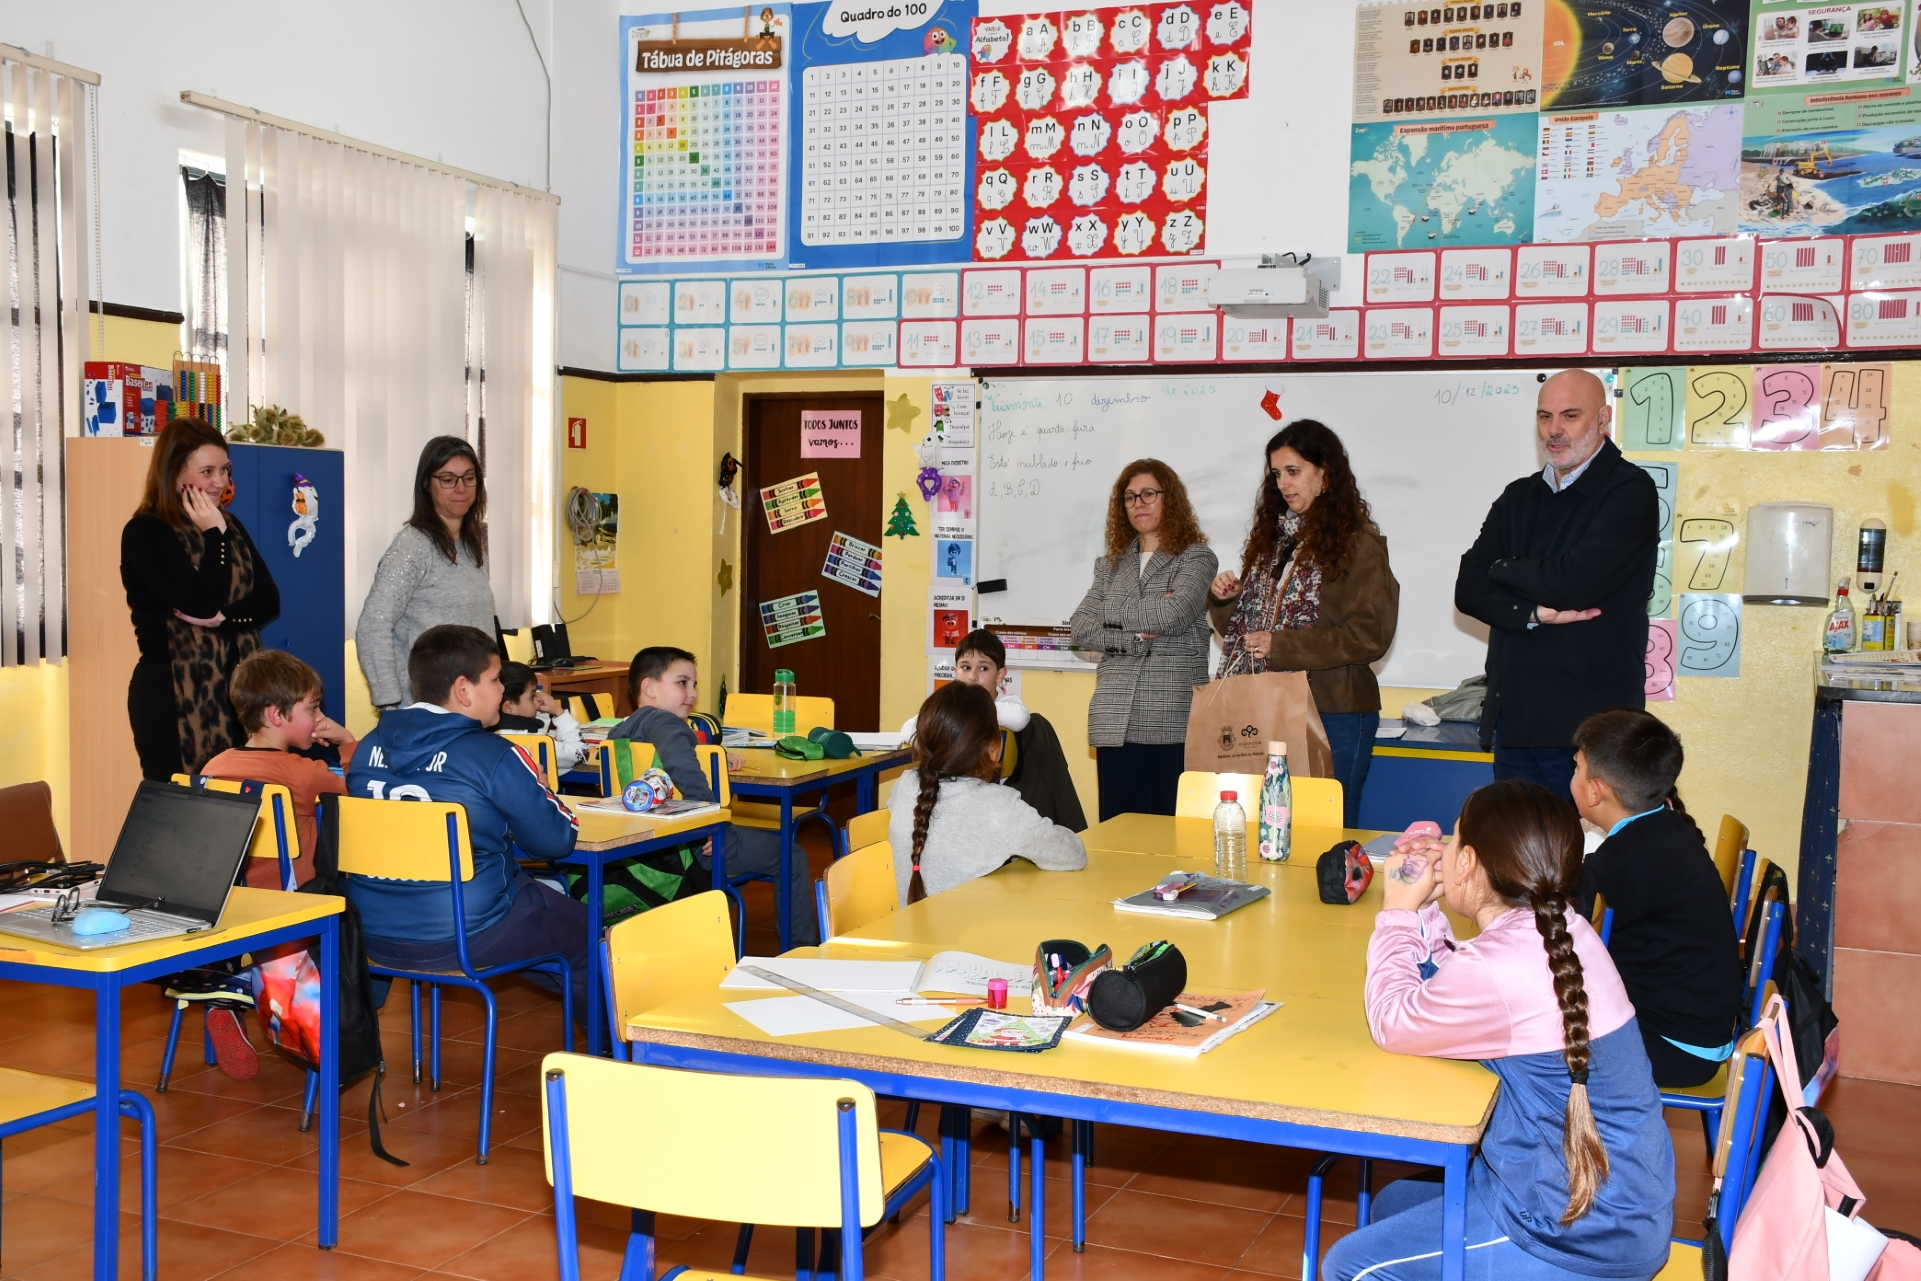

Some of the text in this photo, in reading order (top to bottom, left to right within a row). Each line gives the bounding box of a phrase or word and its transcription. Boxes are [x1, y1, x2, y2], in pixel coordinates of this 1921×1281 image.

[840, 2, 928, 24] Quadro do 100
[1180, 12, 1190, 24] D
[1231, 8, 1238, 19] E
[1807, 5, 1852, 16] SEGURANÇA
[975, 33, 1010, 43] Alfabeto!
[642, 47, 774, 69] Tábua de Pitágoras
[1227, 60, 1236, 72] K
[1188, 114, 1197, 126] P
[1554, 113, 1594, 123] União Europeia
[1399, 122, 1490, 135] Expansão marítima portuguesa
[1090, 170, 1099, 181] S
[1042, 222, 1054, 234] W
[1088, 220, 1098, 232] X
[1681, 250, 1704, 267] 30
[1765, 252, 1788, 269] 50
[1856, 247, 1878, 265] 70
[1444, 266, 1464, 281] 24
[1520, 263, 1541, 278] 26
[1598, 260, 1619, 276] 28
[1370, 269, 1391, 285] 22
[966, 283, 984, 300] 12
[1030, 281, 1048, 298] 14
[1094, 279, 1112, 297] 16
[1160, 277, 1177, 295] 18
[1680, 309, 1702, 326] 40
[1763, 305, 1786, 322] 60
[1851, 303, 1874, 320] 80
[1368, 325, 1388, 341] 23
[1442, 322, 1462, 338] 25
[1519, 320, 1538, 337] 27
[1597, 318, 1618, 334] 29
[965, 331, 982, 348] 13
[1029, 330, 1046, 347] 15
[1093, 328, 1110, 345] 17
[1158, 326, 1177, 344] 19
[1056, 392, 1073, 407] 10
[1091, 392, 1151, 413] dezembro
[1161, 384, 1177, 396] de
[1762, 370, 1815, 443] 3
[1825, 369, 1886, 443] 4
[1630, 372, 1673, 444] 1
[1692, 371, 1747, 444] 2
[803, 418, 858, 431] TODOS JUNTOS
[988, 420, 1016, 445] Hoje
[1020, 425, 1030, 437] é
[988, 454, 1010, 470] Está
[1017, 452, 1059, 469] nublado
[1072, 451, 1094, 471] frio
[777, 495, 799, 505] Aprender
[848, 541, 866, 552] Brincar
[1680, 518, 1734, 590] 7
[840, 560, 862, 573] Partilhar
[838, 570, 857, 582] Crescer
[776, 611, 797, 619] Imaginar
[778, 620, 800, 629] Respeitar
[1828, 619, 1849, 632] AJAX
[780, 631, 804, 640] Conversar
[1681, 599, 1738, 670] 9
